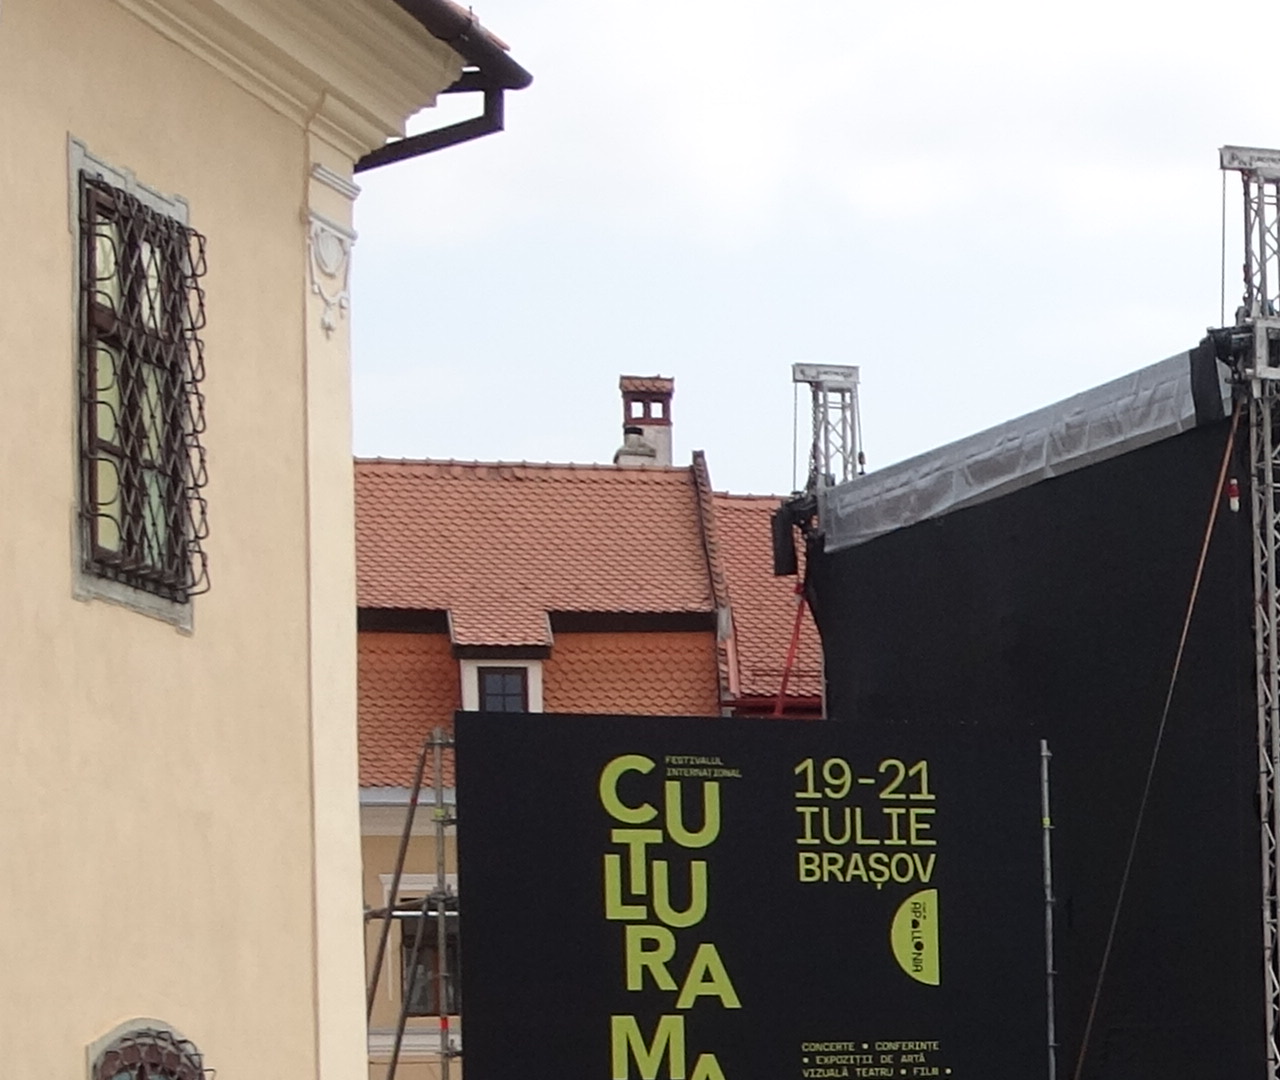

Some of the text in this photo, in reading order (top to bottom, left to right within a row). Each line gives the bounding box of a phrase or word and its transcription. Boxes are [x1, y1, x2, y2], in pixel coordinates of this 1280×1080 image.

[794, 758, 936, 800] 19-21
[795, 806, 937, 846] IULIE
[798, 852, 936, 890] BRAȘOV
[801, 1042, 855, 1052] CONCERTE
[880, 1055, 894, 1064] DE
[901, 1053, 926, 1063] ARTĂ
[856, 1068, 894, 1077] TEATRU
[913, 1067, 939, 1076] FILM
